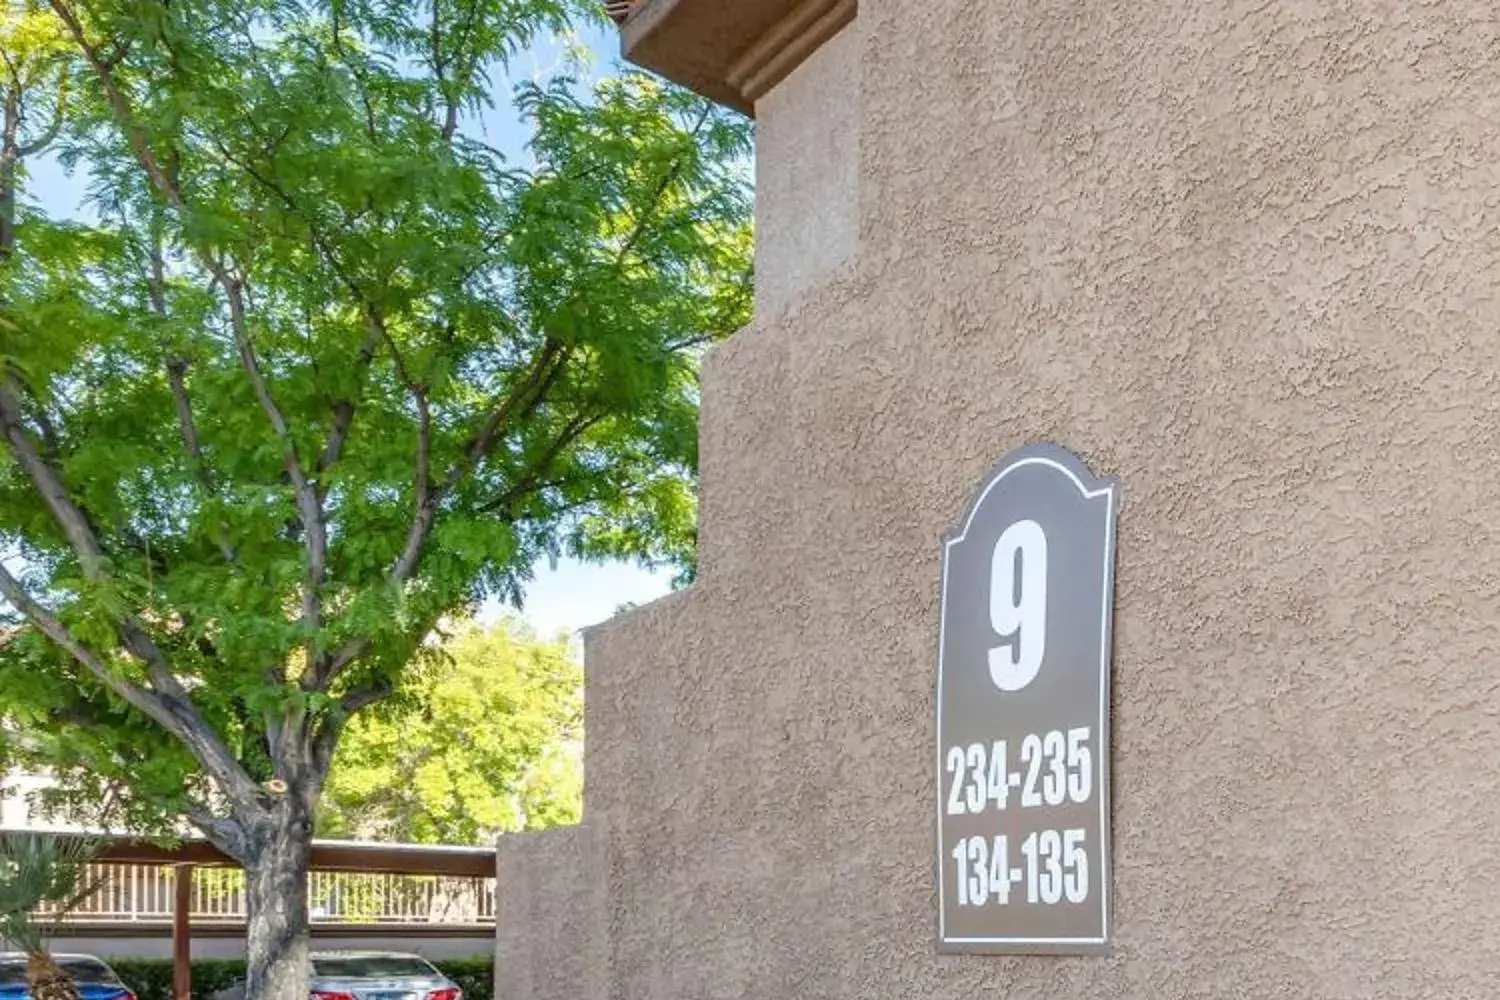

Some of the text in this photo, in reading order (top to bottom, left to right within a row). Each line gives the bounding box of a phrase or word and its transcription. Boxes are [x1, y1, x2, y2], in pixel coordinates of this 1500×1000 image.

[988, 519, 1048, 692] 9
[946, 727, 1091, 815] 234-235
[951, 828, 1090, 906] 134-135
